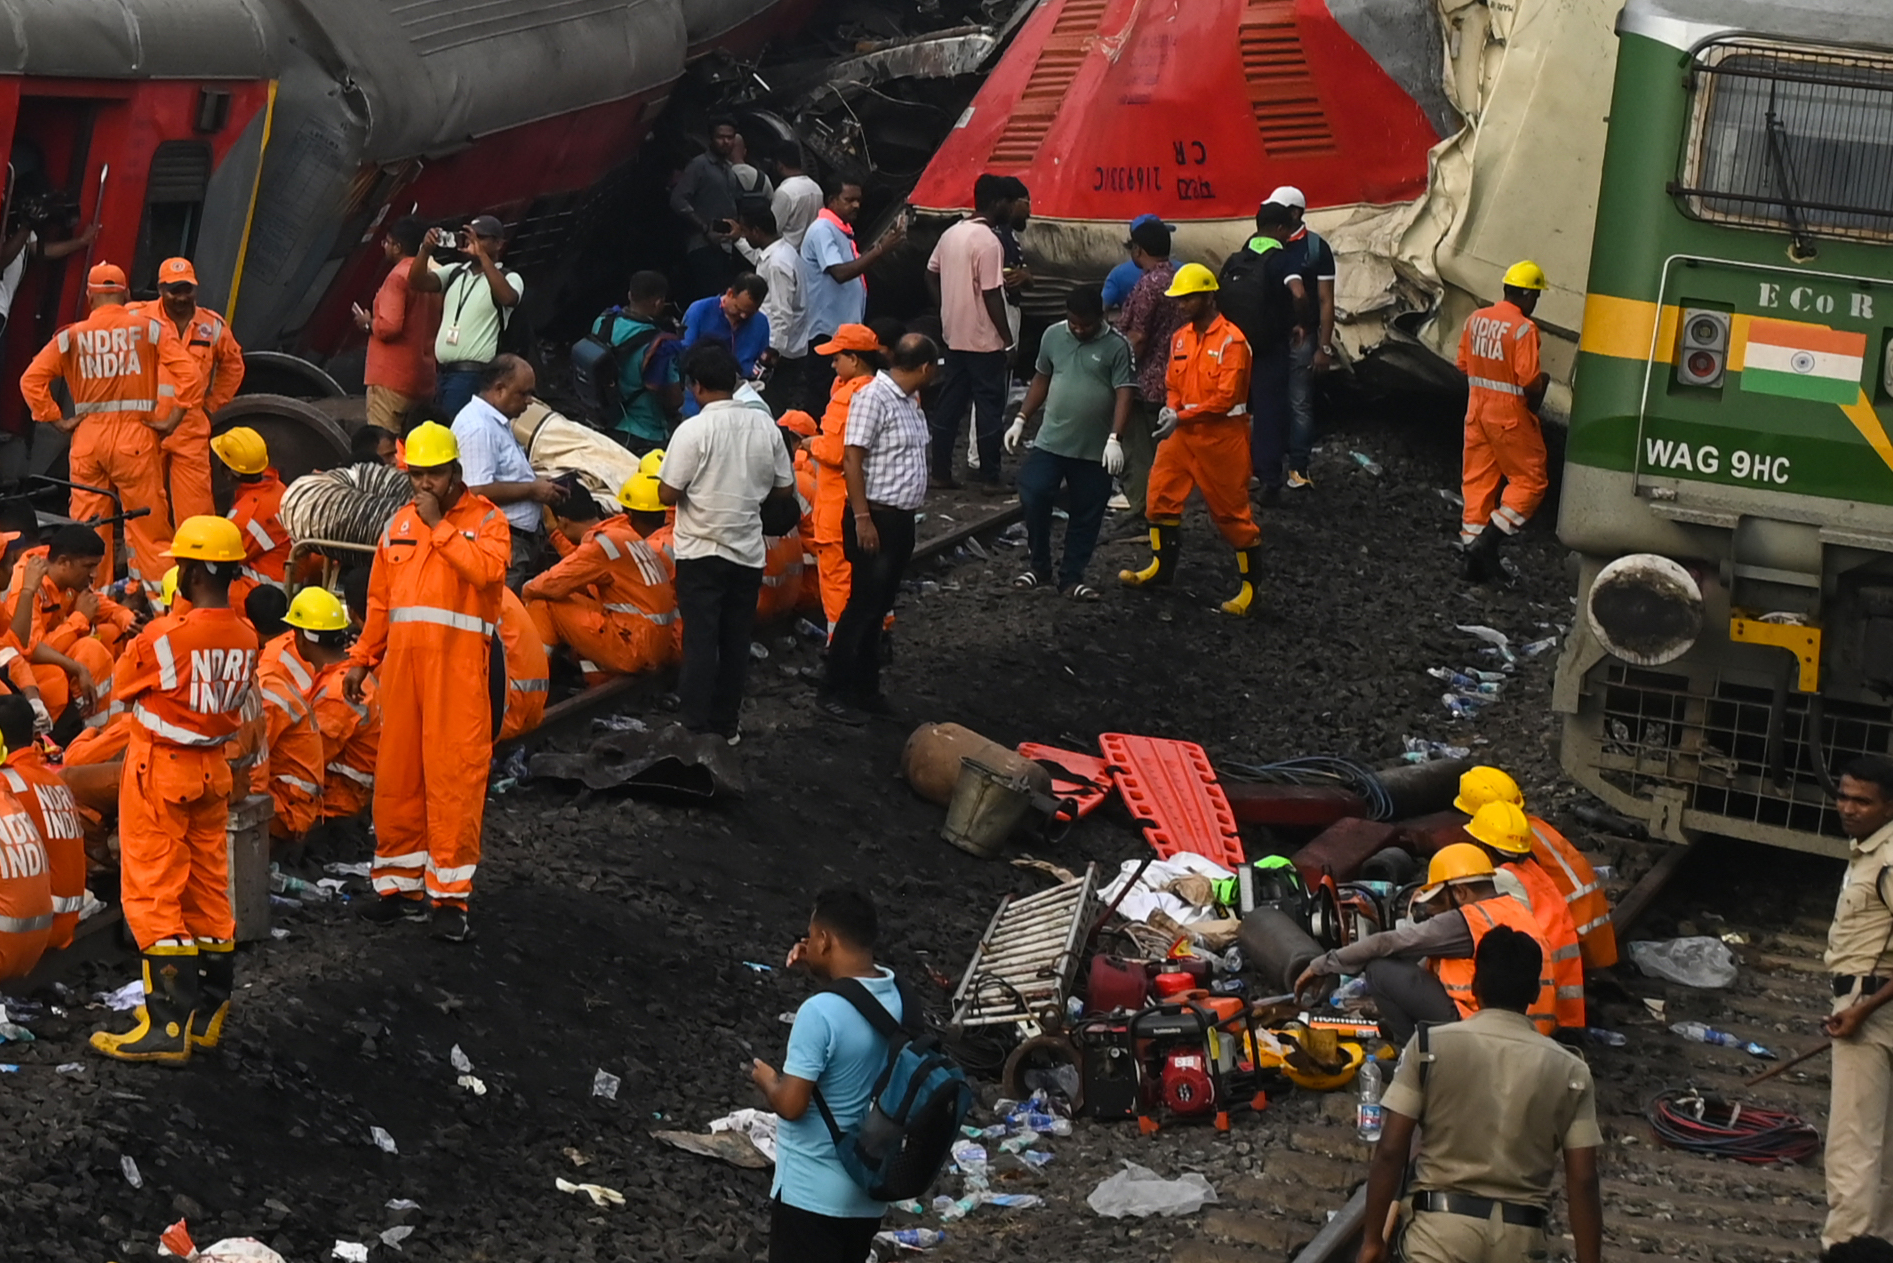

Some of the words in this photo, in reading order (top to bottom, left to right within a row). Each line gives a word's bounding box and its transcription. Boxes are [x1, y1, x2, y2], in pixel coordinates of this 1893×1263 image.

[1850, 293, 1874, 319] R
[77, 326, 142, 354] NDRF
[1470, 317, 1512, 339] NDRF
[1471, 336, 1504, 361] NDIA
[79, 350, 141, 379] INDIA
[1646, 438, 1719, 474] WAG
[1731, 450, 1791, 484] 9HC
[191, 648, 256, 683] NDRF
[189, 680, 249, 715] INDIA
[32, 782, 75, 812] NDR
